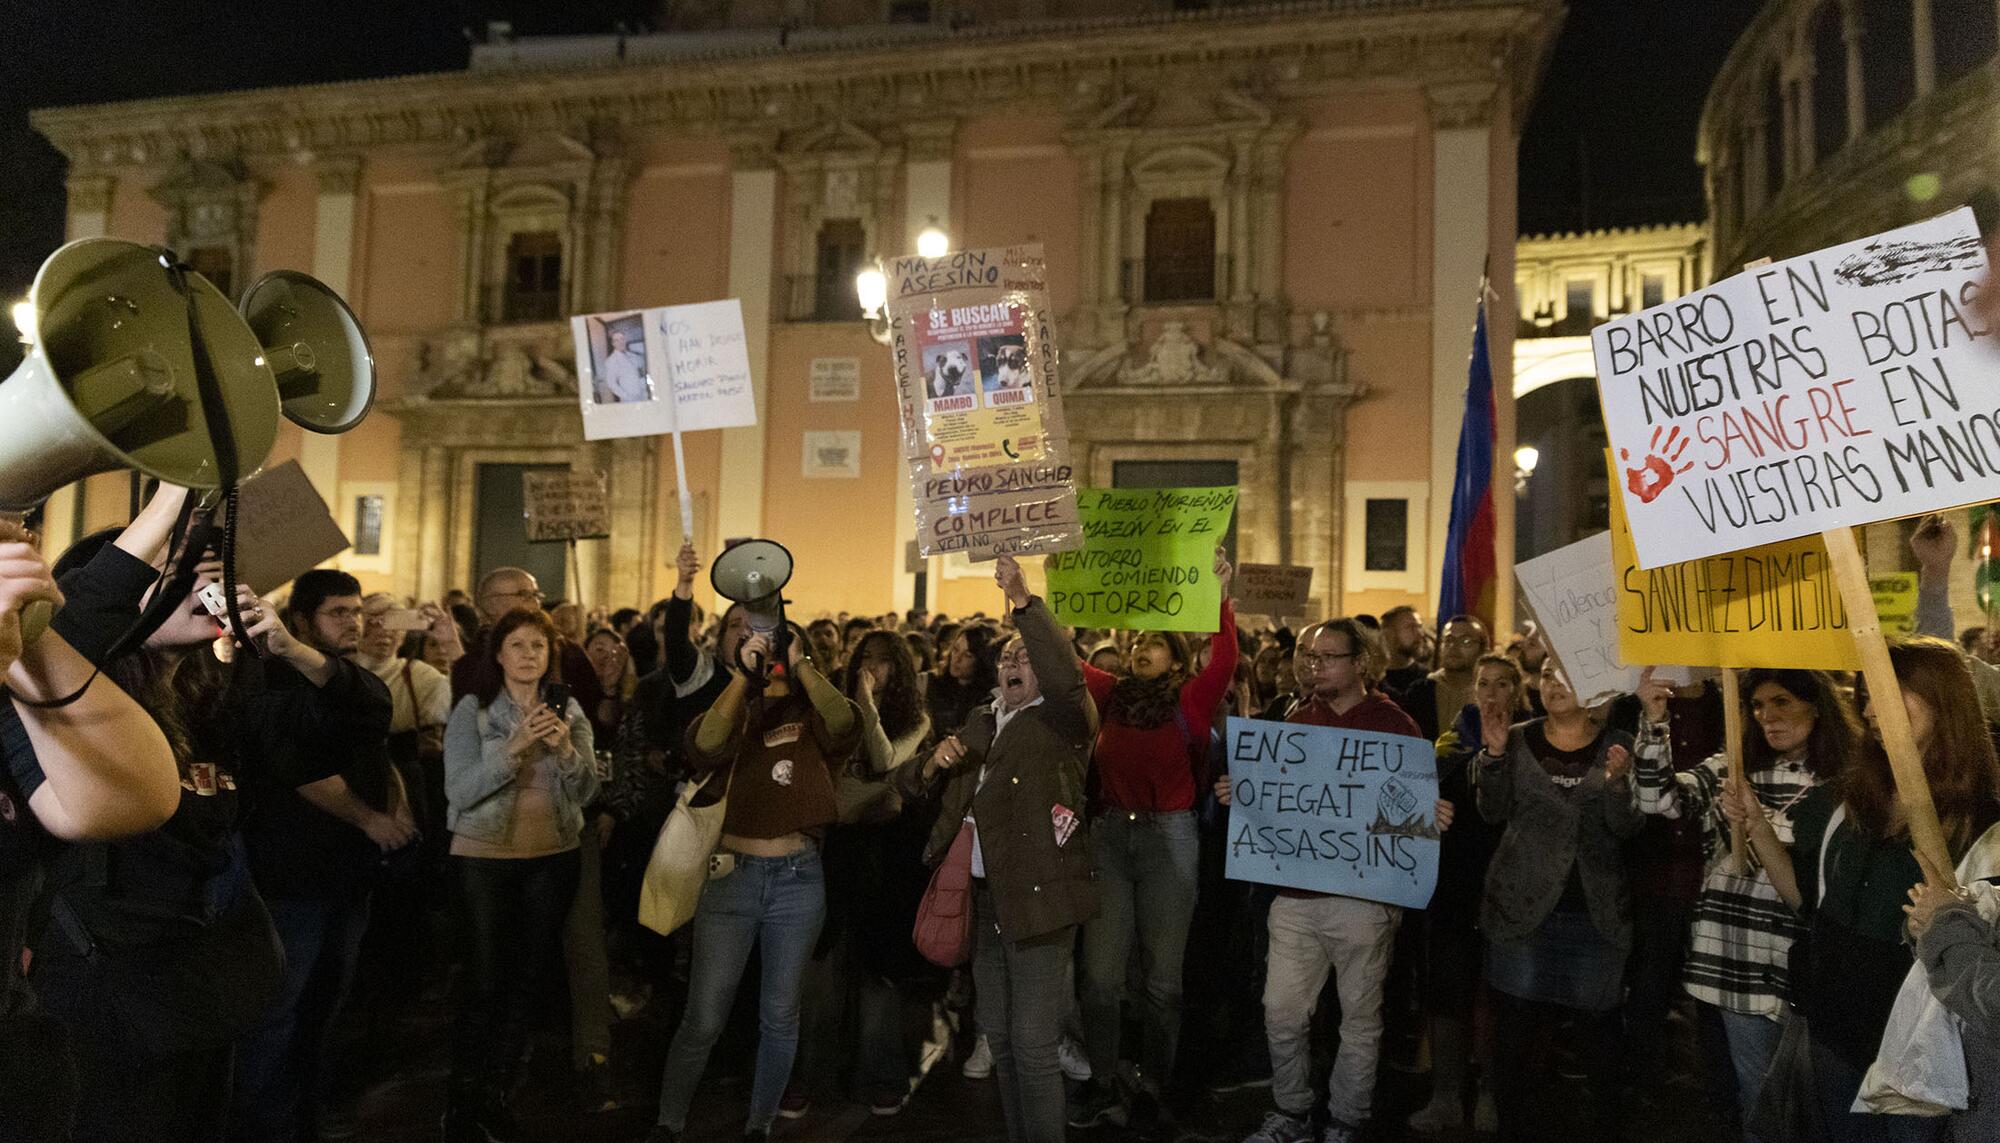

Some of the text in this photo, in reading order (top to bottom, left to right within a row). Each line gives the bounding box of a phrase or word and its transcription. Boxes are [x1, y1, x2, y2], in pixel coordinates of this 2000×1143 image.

[901, 266, 998, 293] ASESINO
[928, 304, 1010, 330] SE BUSCAN
[1607, 260, 1830, 375] BARRO EN
[1037, 310, 1057, 398] CARCEL
[1638, 325, 1828, 424] NUESTRAS
[934, 397, 973, 412] MAMBO
[992, 390, 1025, 405] QUIMA
[1697, 357, 1961, 471] SANGRE EN
[1682, 408, 2000, 533] VUESTRAS MANO
[926, 473, 993, 498] PEDRO
[1098, 493, 1150, 511] PUEBLO
[1153, 492, 1234, 511] MURIENDO
[934, 501, 1061, 536] COMPLICE
[1157, 518, 1183, 535] EN
[1189, 517, 1212, 533] EL
[973, 534, 990, 548] NO
[1053, 549, 1143, 571] VENTORRO
[1101, 566, 1199, 587] COMIENDO
[1052, 589, 1183, 616] POTORRO
[1624, 557, 1739, 633] SANCHEZ
[1746, 551, 1849, 631] DIMISIO
[1235, 730, 1404, 772] ENS HEU
[1236, 779, 1365, 818] OFEGAT
[1232, 824, 1417, 871] ASSASSINS
